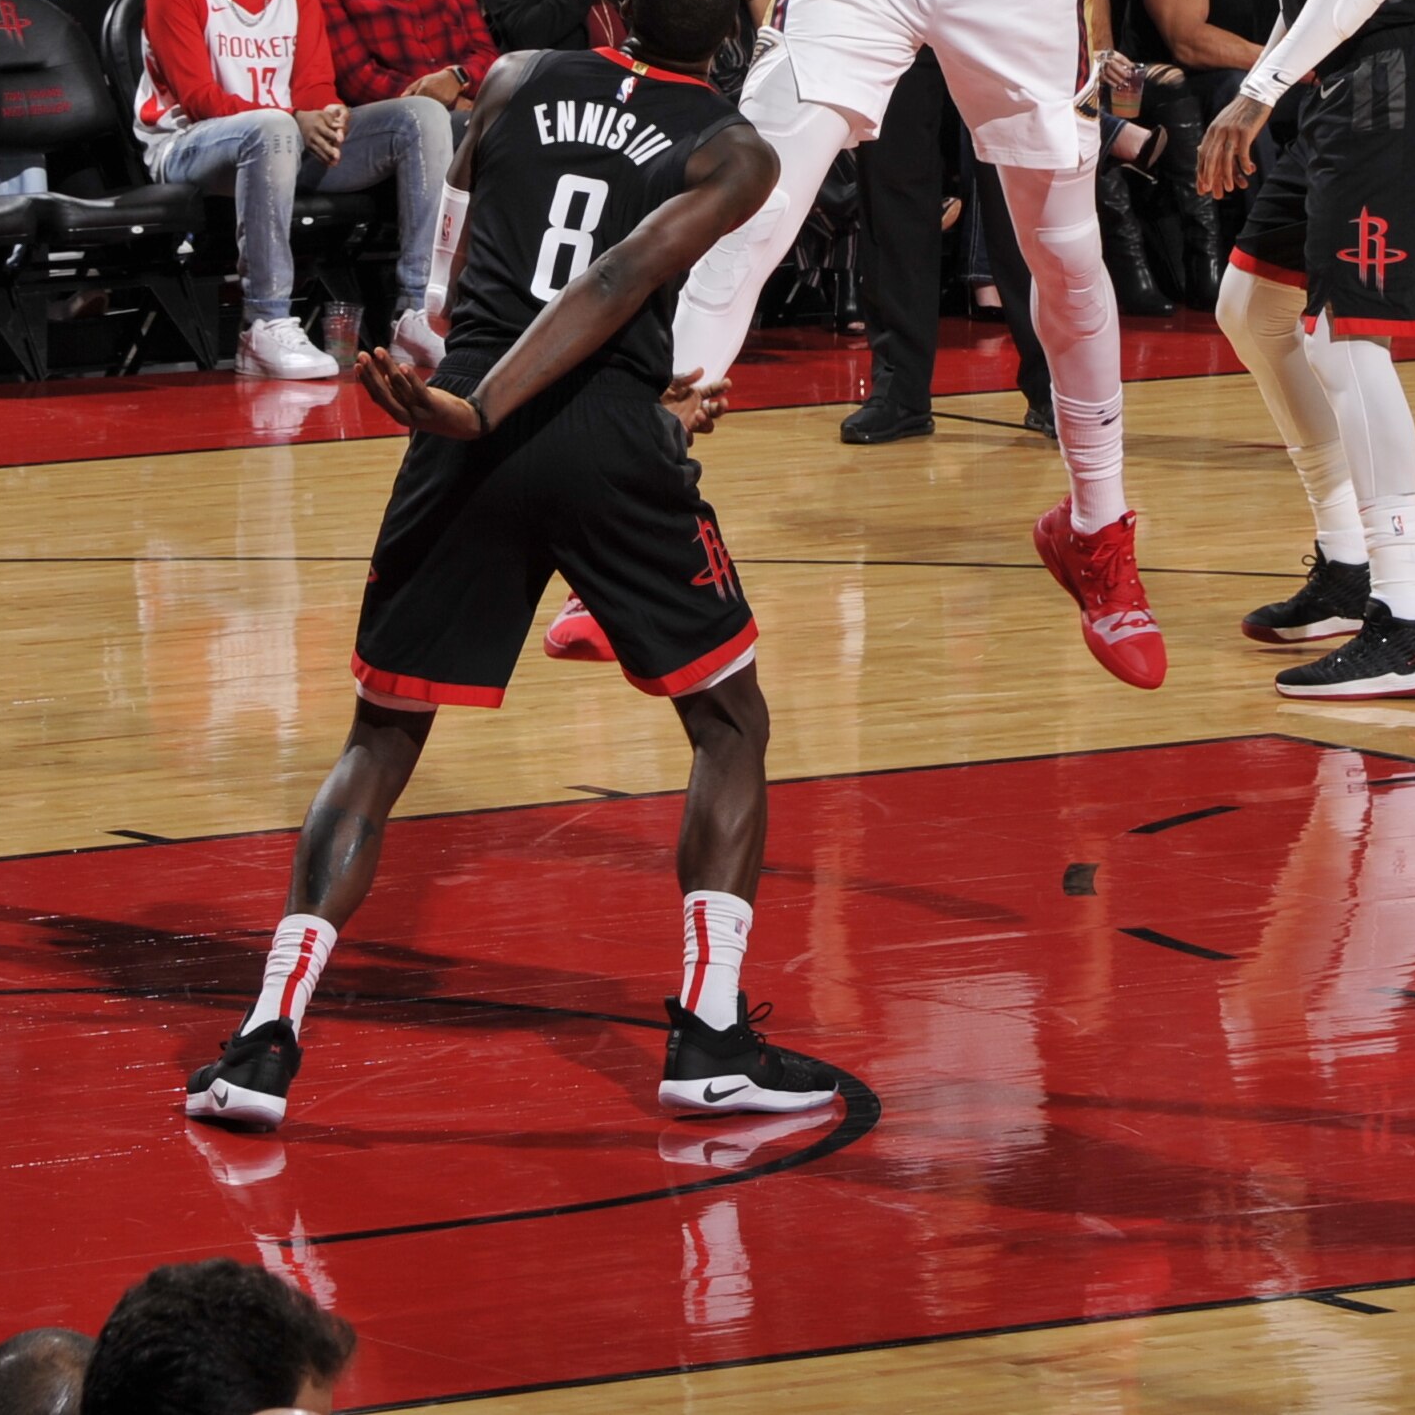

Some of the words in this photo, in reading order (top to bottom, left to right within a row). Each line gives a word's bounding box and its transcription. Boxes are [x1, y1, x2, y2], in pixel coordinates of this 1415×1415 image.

[534, 100, 637, 151] ENNIS
[623, 124, 673, 167] III
[530, 173, 610, 304] 8
